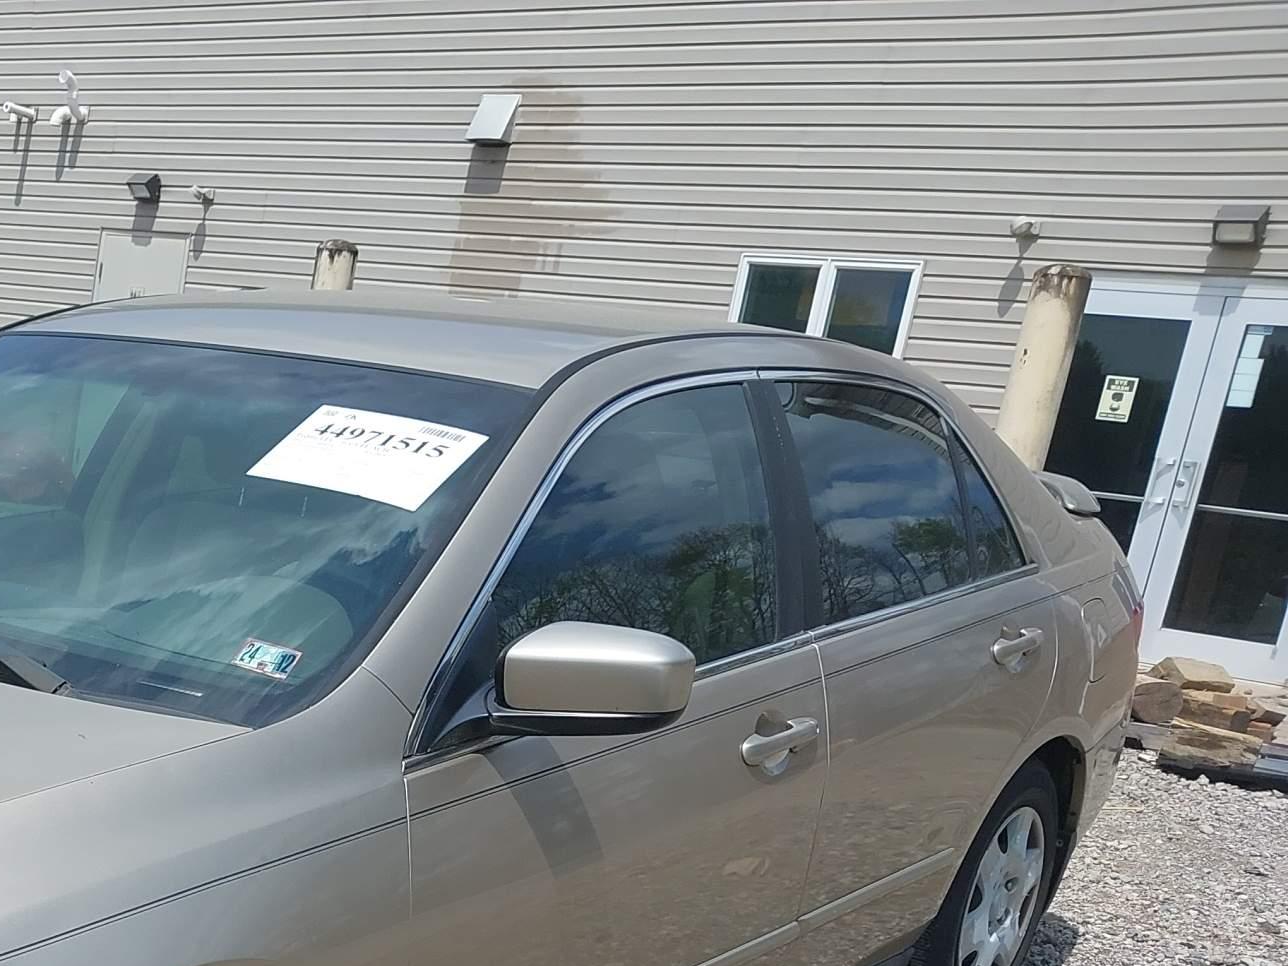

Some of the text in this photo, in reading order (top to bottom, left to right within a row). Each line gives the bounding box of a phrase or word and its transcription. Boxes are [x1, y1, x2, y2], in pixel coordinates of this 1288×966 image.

[314, 423, 450, 458] 44971515
[239, 643, 261, 664] 24
[275, 653, 297, 674] 12
